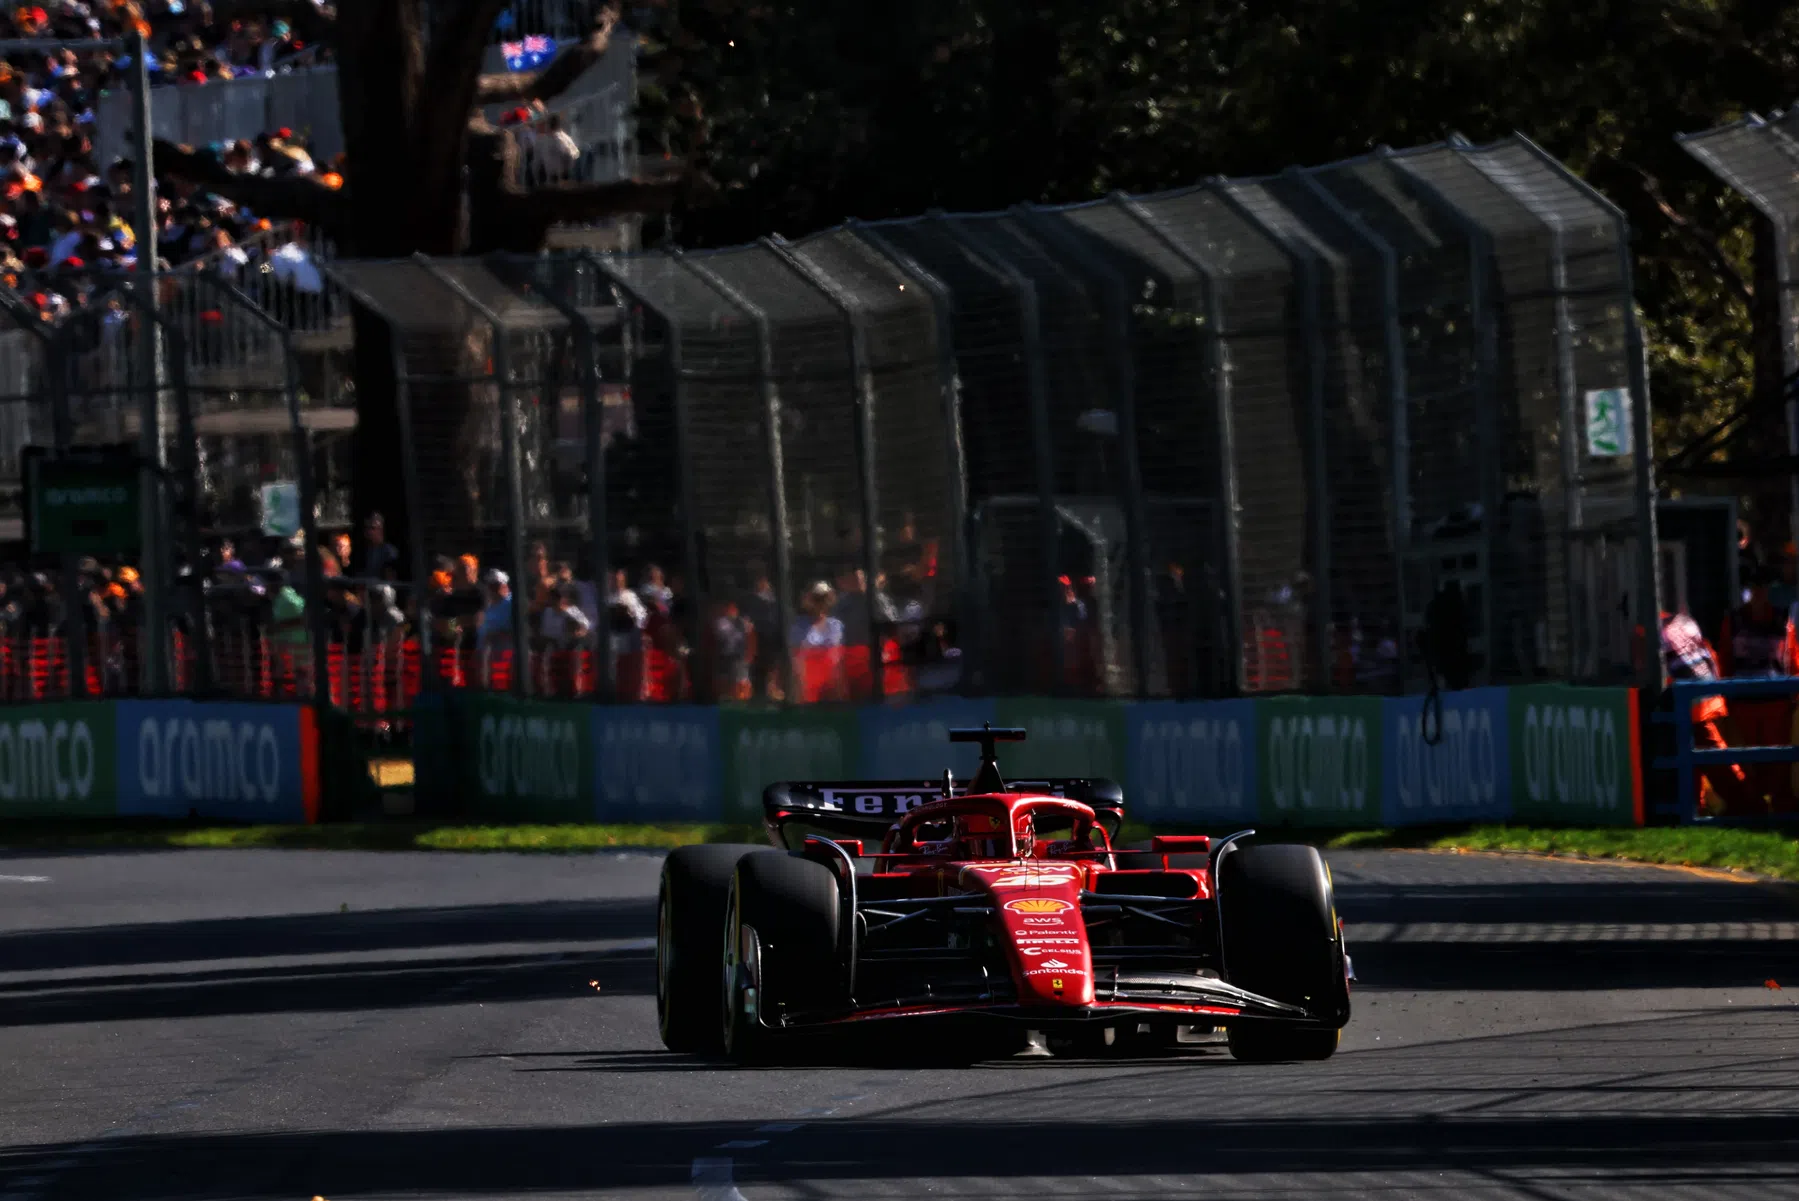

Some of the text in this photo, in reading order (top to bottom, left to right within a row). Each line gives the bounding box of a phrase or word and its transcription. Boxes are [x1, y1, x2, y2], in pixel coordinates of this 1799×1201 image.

[0, 718, 94, 801] amco
[138, 716, 280, 803] aramco
[1523, 704, 1617, 810] aramco
[1022, 968, 1089, 977] Santander
